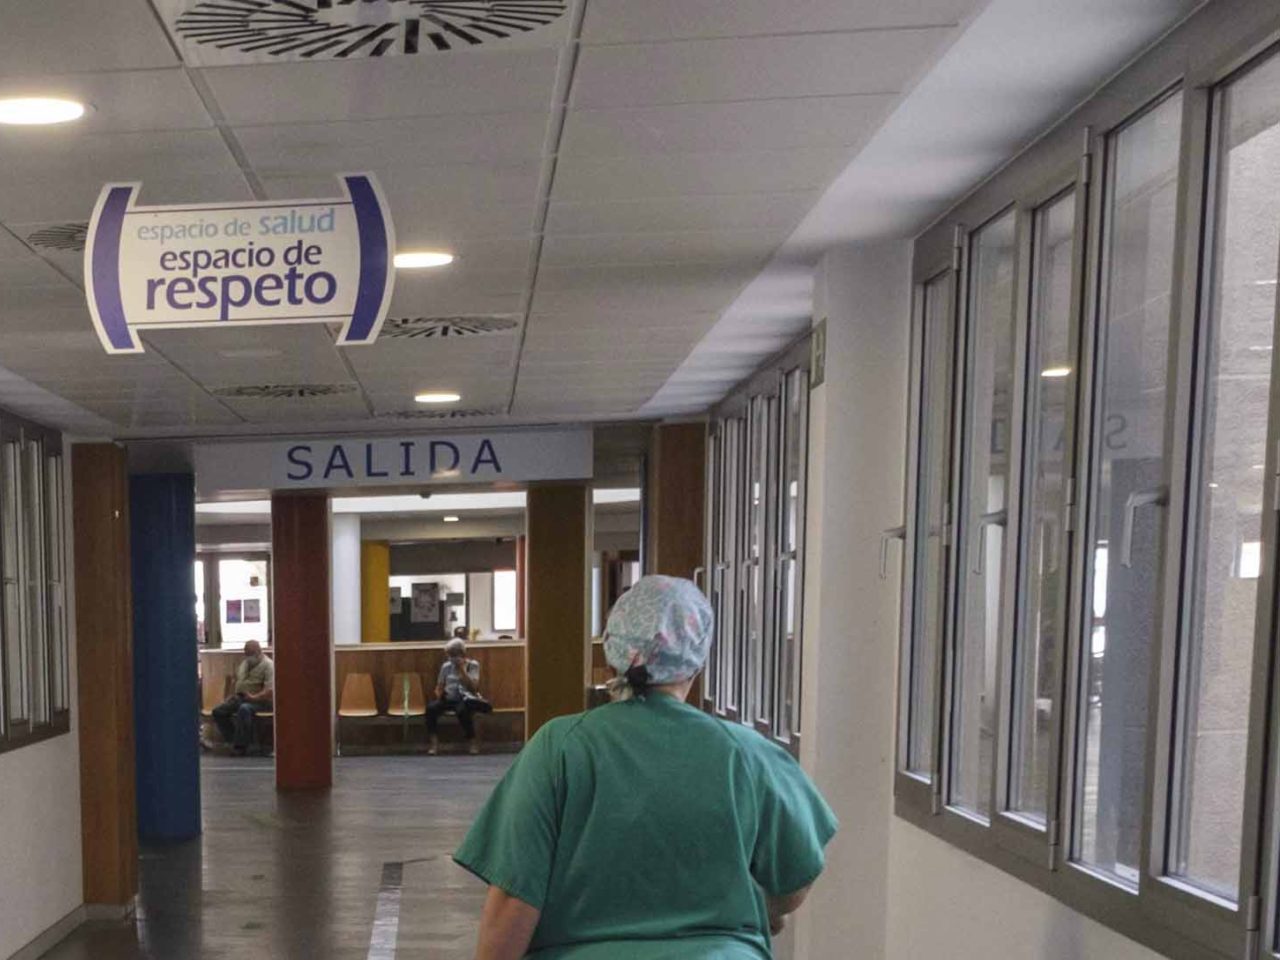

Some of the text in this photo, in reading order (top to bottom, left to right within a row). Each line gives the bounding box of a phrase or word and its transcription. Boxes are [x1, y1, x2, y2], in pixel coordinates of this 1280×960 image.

[137, 208, 334, 245] espacio de salud
[160, 240, 322, 277] espacio de
[146, 266, 337, 321] respeto
[286, 438, 503, 481] SALIDA
